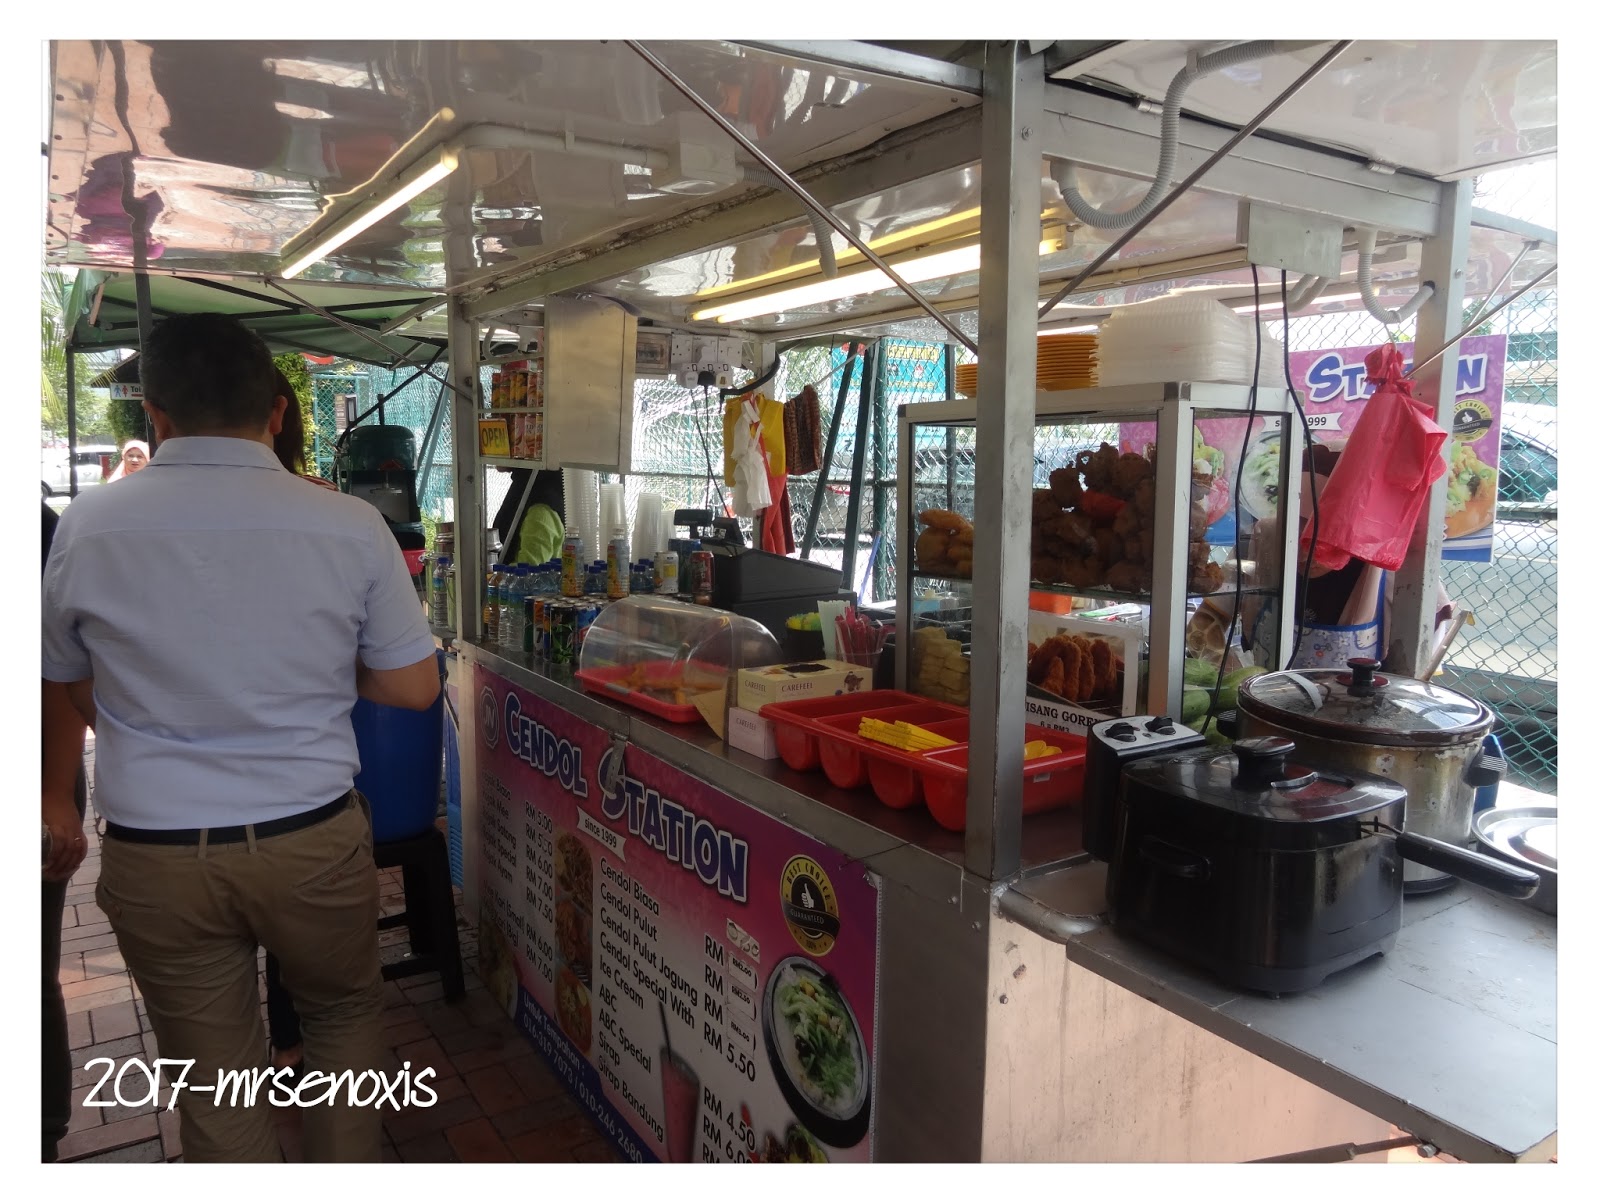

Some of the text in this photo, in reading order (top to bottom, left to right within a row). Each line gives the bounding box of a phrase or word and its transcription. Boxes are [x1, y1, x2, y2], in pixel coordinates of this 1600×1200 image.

[130, 385, 143, 393] Toi
[481, 427, 506, 448] OPEN
[1306, 416, 1327, 427] 999
[781, 682, 813, 693] CAREFEEL
[1025, 701, 1058, 719] ISANG
[504, 691, 748, 903] CENDOL STATION
[525, 800, 536, 821] RM
[537, 811, 553, 834] 5.00
[525, 823, 536, 844] RM
[584, 818, 618, 849] since 1999
[526, 844, 536, 865] RM
[537, 855, 553, 879] 6.00
[526, 865, 537, 886] RM
[537, 877, 553, 901] 7.00
[786, 862, 831, 900] BEST CHOICE
[526, 887, 537, 907] RM
[537, 899, 553, 923] 7.50
[600, 857, 632, 894] Cendol
[634, 881, 660, 917] Biasa
[705, 934, 724, 967] RM
[526, 923, 537, 944] RM
[537, 936, 553, 962] 6.00
[600, 882, 724, 996] Cendol Pulut RM
[526, 944, 537, 965] RM
[537, 956, 553, 985] 7.00
[600, 906, 724, 1025] Cendol Pulut Jagung RM
[600, 954, 645, 1010] Ice Cream
[732, 957, 752, 978] RM2.00
[600, 931, 757, 1082] Cendol Special With RM 5.50
[543, 1015, 581, 1071] Tempahan
[598, 1031, 621, 1067] Sirap
[599, 984, 756, 1151] ABC RM 4.50
[599, 1008, 752, 1163] ABC Special RM 6.0
[598, 1055, 665, 1144] Sirap Bandung
